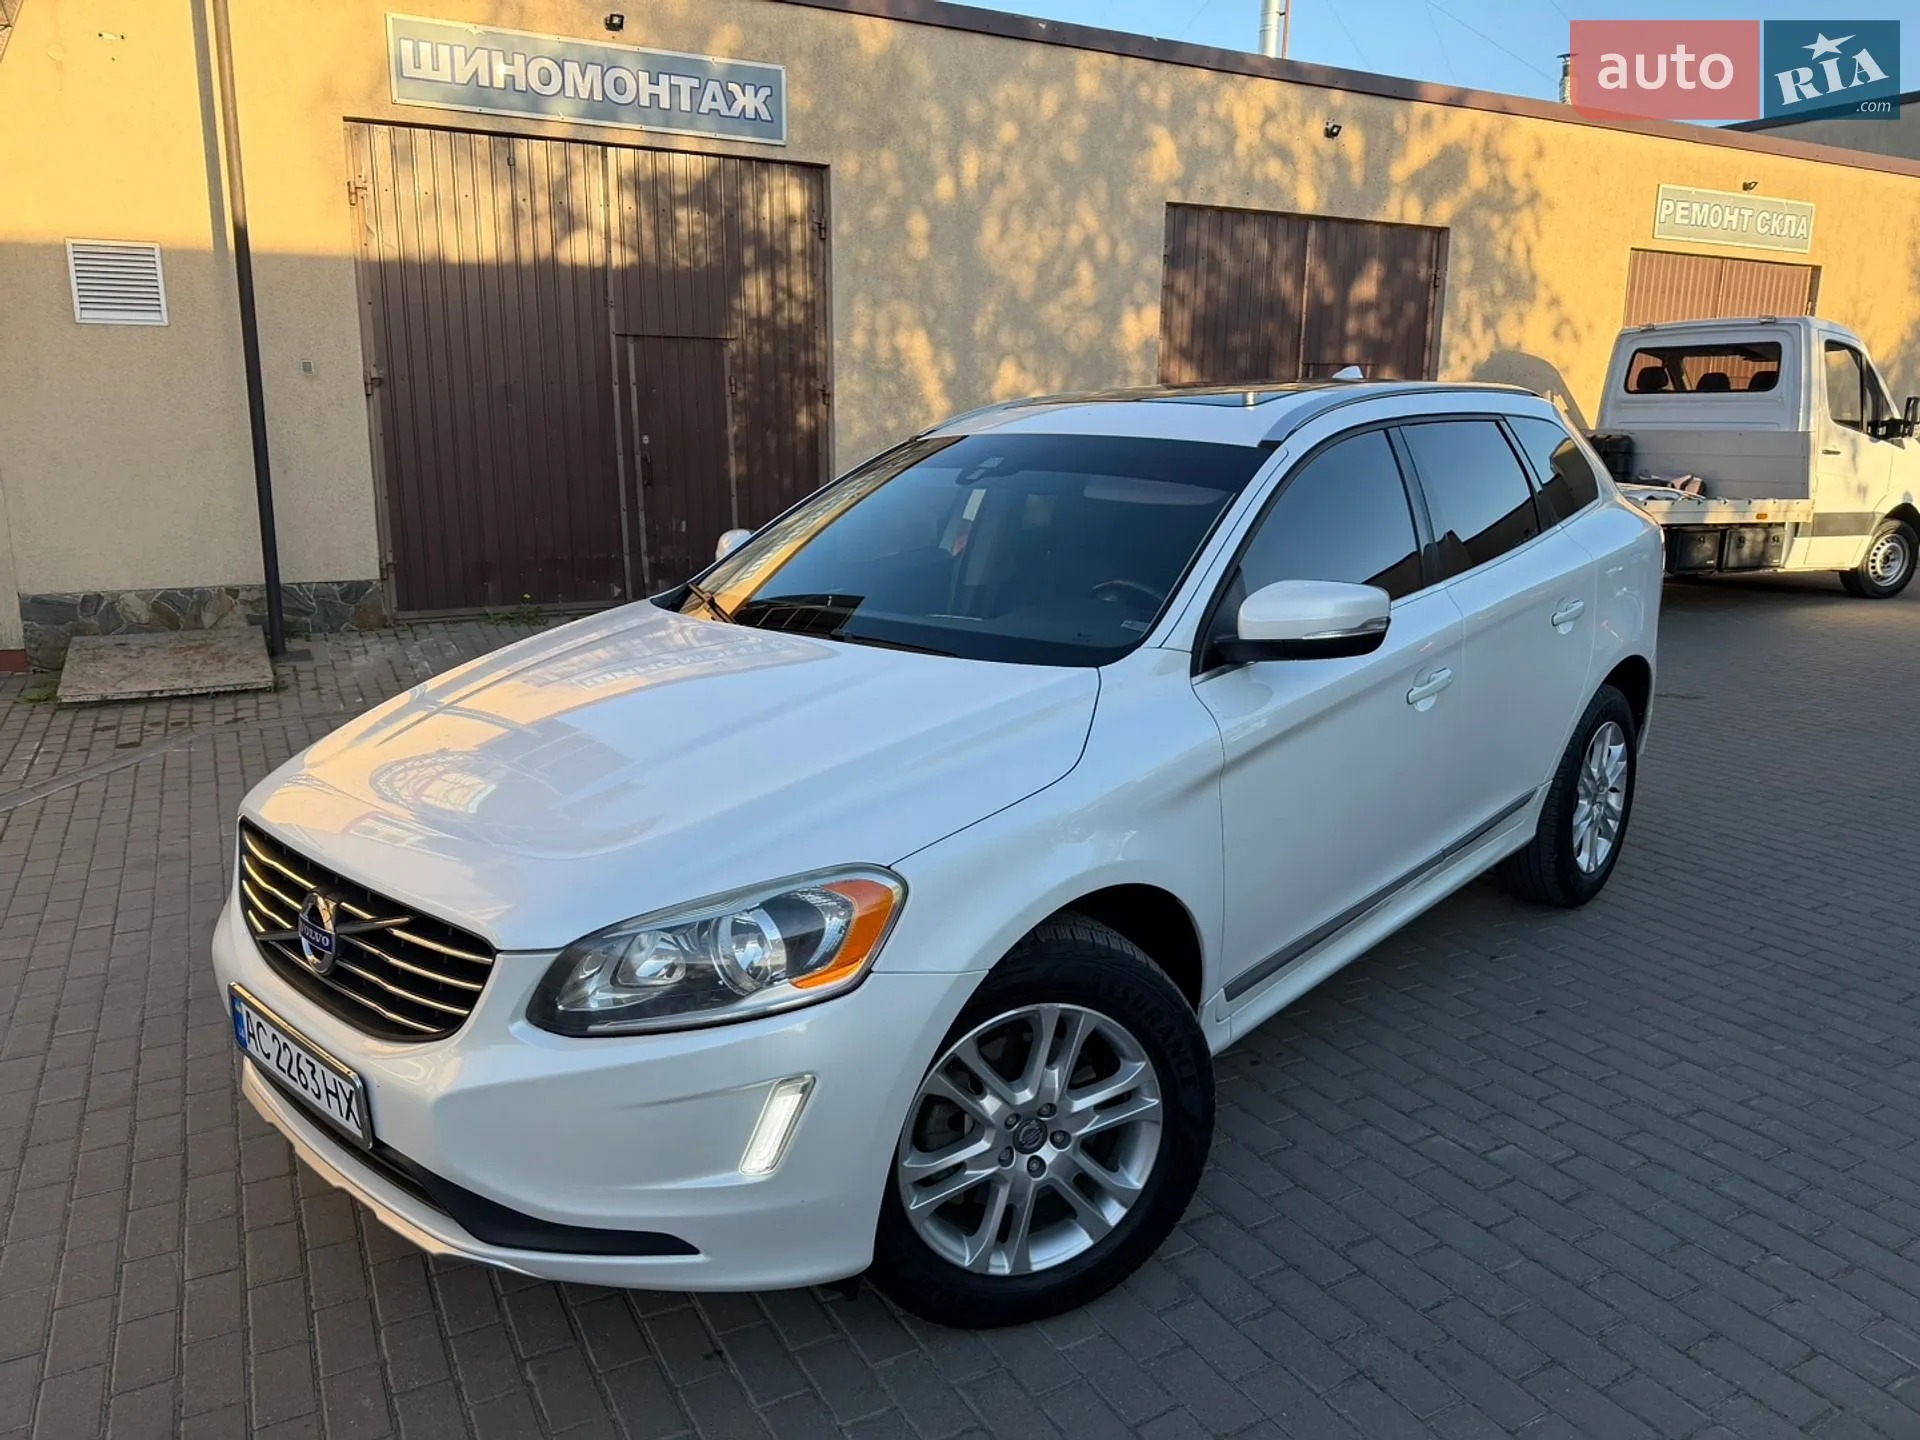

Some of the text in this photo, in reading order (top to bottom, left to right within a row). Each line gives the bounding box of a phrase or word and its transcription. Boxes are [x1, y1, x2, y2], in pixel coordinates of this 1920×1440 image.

[399, 37, 775, 122] ШИНОМОНТАЖ
[1658, 198, 1809, 239] РЕМОНТ СКЛА
[245, 1010, 362, 1130] AC 2263 HX
